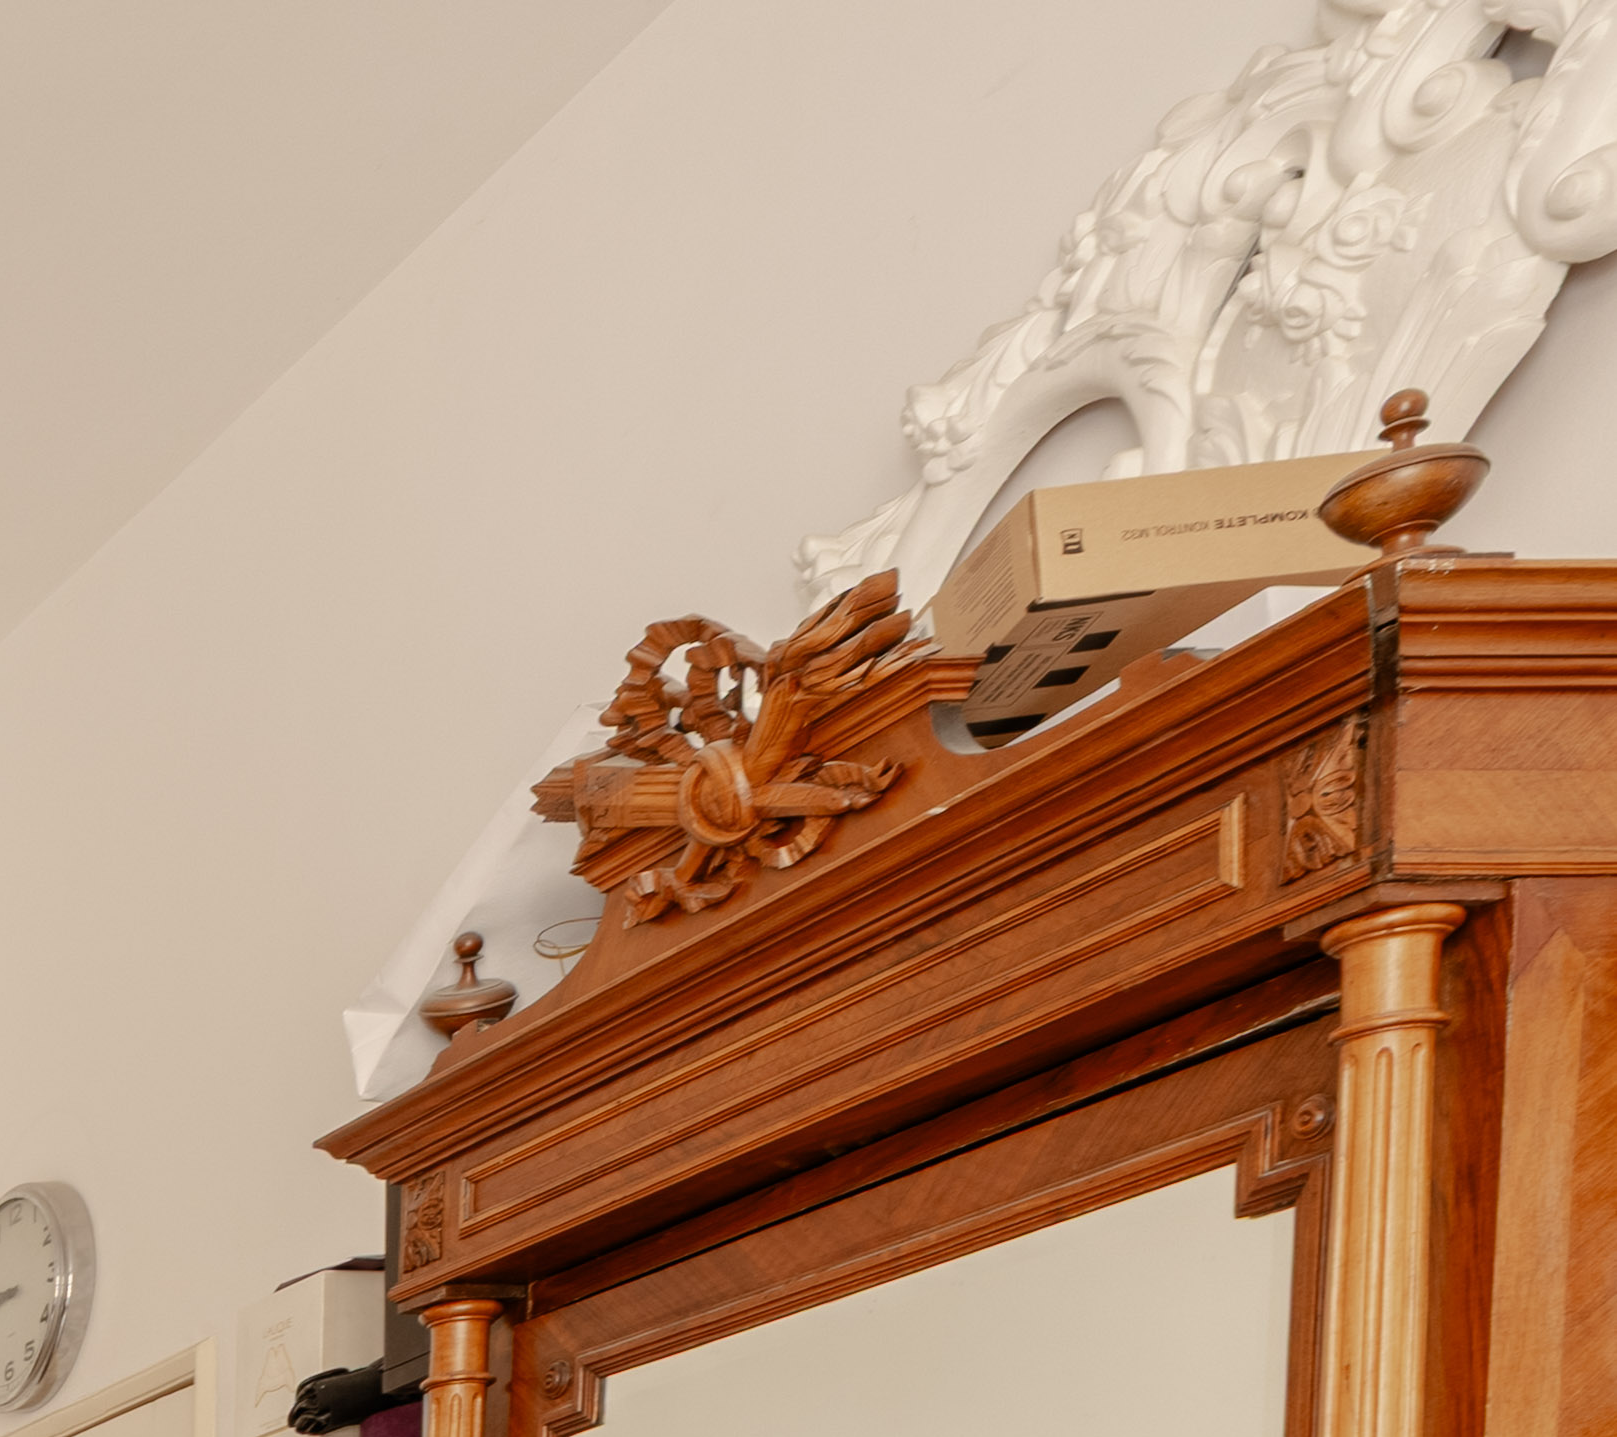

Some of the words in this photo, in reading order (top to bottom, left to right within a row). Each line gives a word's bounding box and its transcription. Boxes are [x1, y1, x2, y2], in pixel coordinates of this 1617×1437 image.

[1154, 520, 1210, 538] KONTROL
[1214, 510, 1309, 529] KOMPLETE
[1120, 526, 1150, 542] M32
[1052, 616, 1093, 642] NKS
[9, 1203, 22, 1227] 12
[40, 1304, 50, 1324] 4
[23, 1340, 35, 1363] 5
[4, 1360, 14, 1381] 6
